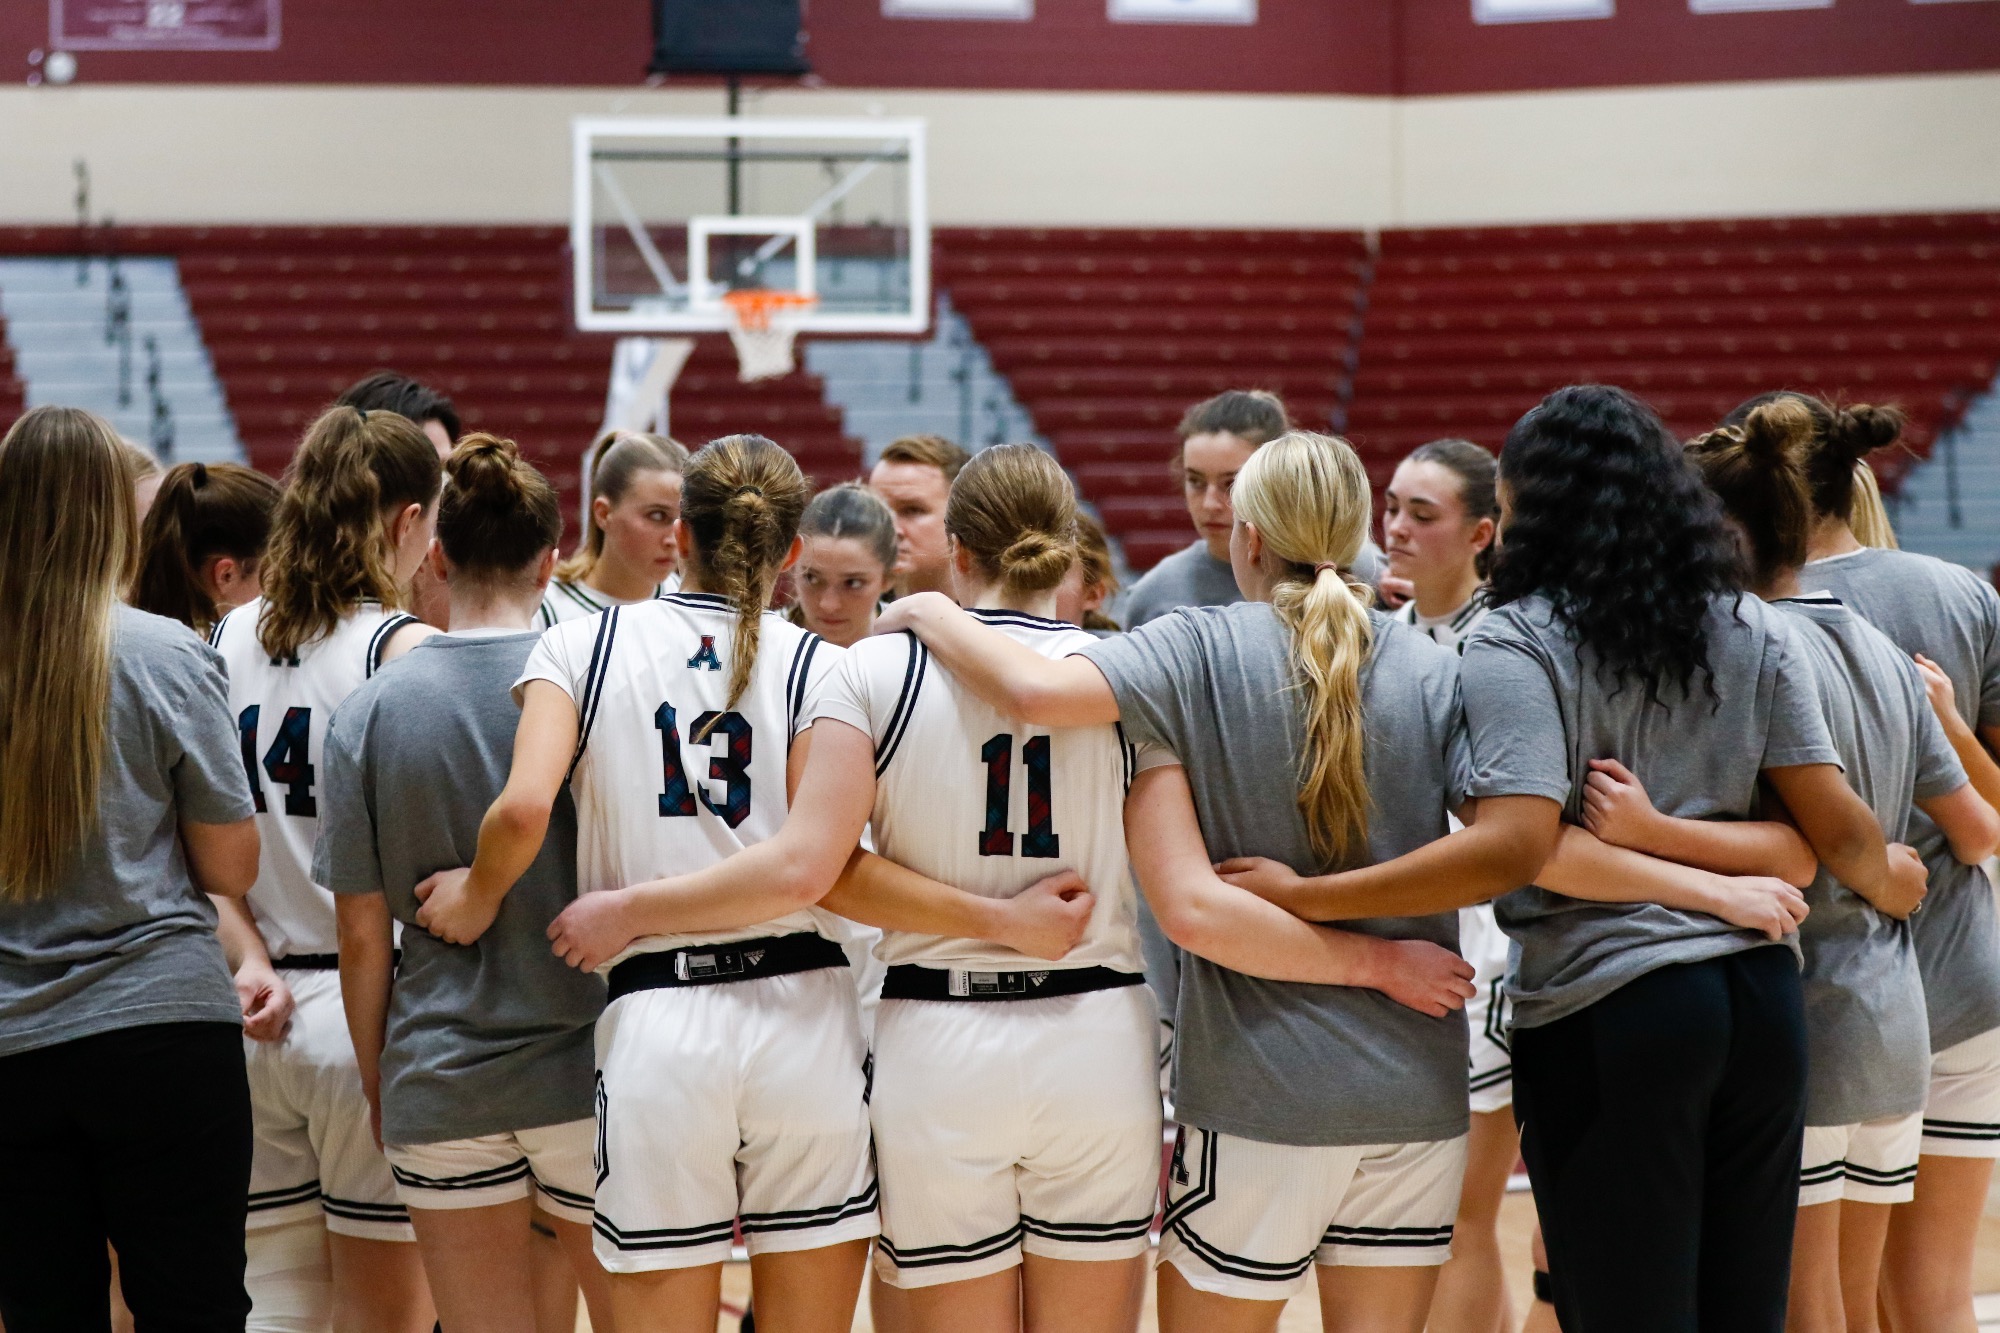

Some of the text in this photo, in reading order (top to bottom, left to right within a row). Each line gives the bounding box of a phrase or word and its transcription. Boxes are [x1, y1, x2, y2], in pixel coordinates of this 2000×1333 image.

[687, 635, 722, 671] A
[238, 704, 317, 817] 14
[655, 701, 752, 829] 13
[979, 733, 1059, 858] 11
[725, 955, 731, 964] S
[743, 949, 766, 957] adidas
[1007, 974, 1014, 983] M
[1027, 970, 1049, 978] adidas
